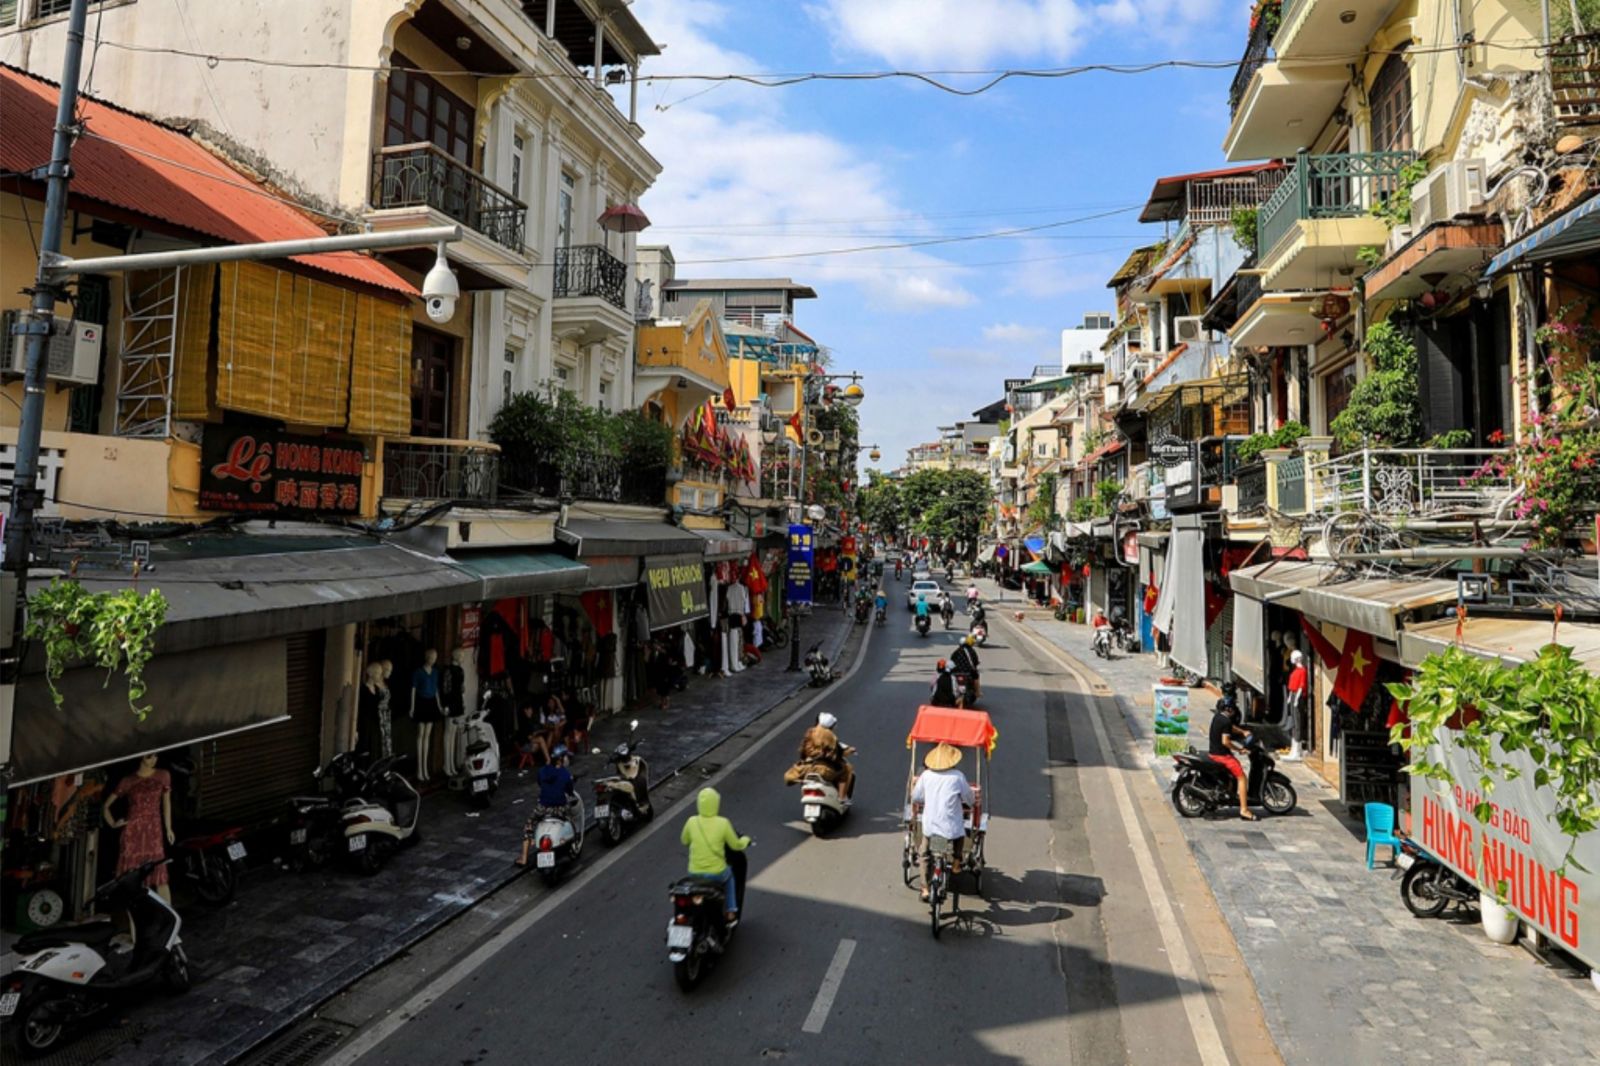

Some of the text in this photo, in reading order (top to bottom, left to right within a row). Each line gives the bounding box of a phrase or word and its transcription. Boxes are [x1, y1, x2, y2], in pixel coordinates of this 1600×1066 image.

[276, 442, 363, 477] HONG KONG
[1502, 807, 1531, 846] ĐÀO
[1482, 831, 1580, 950] NHUNG
